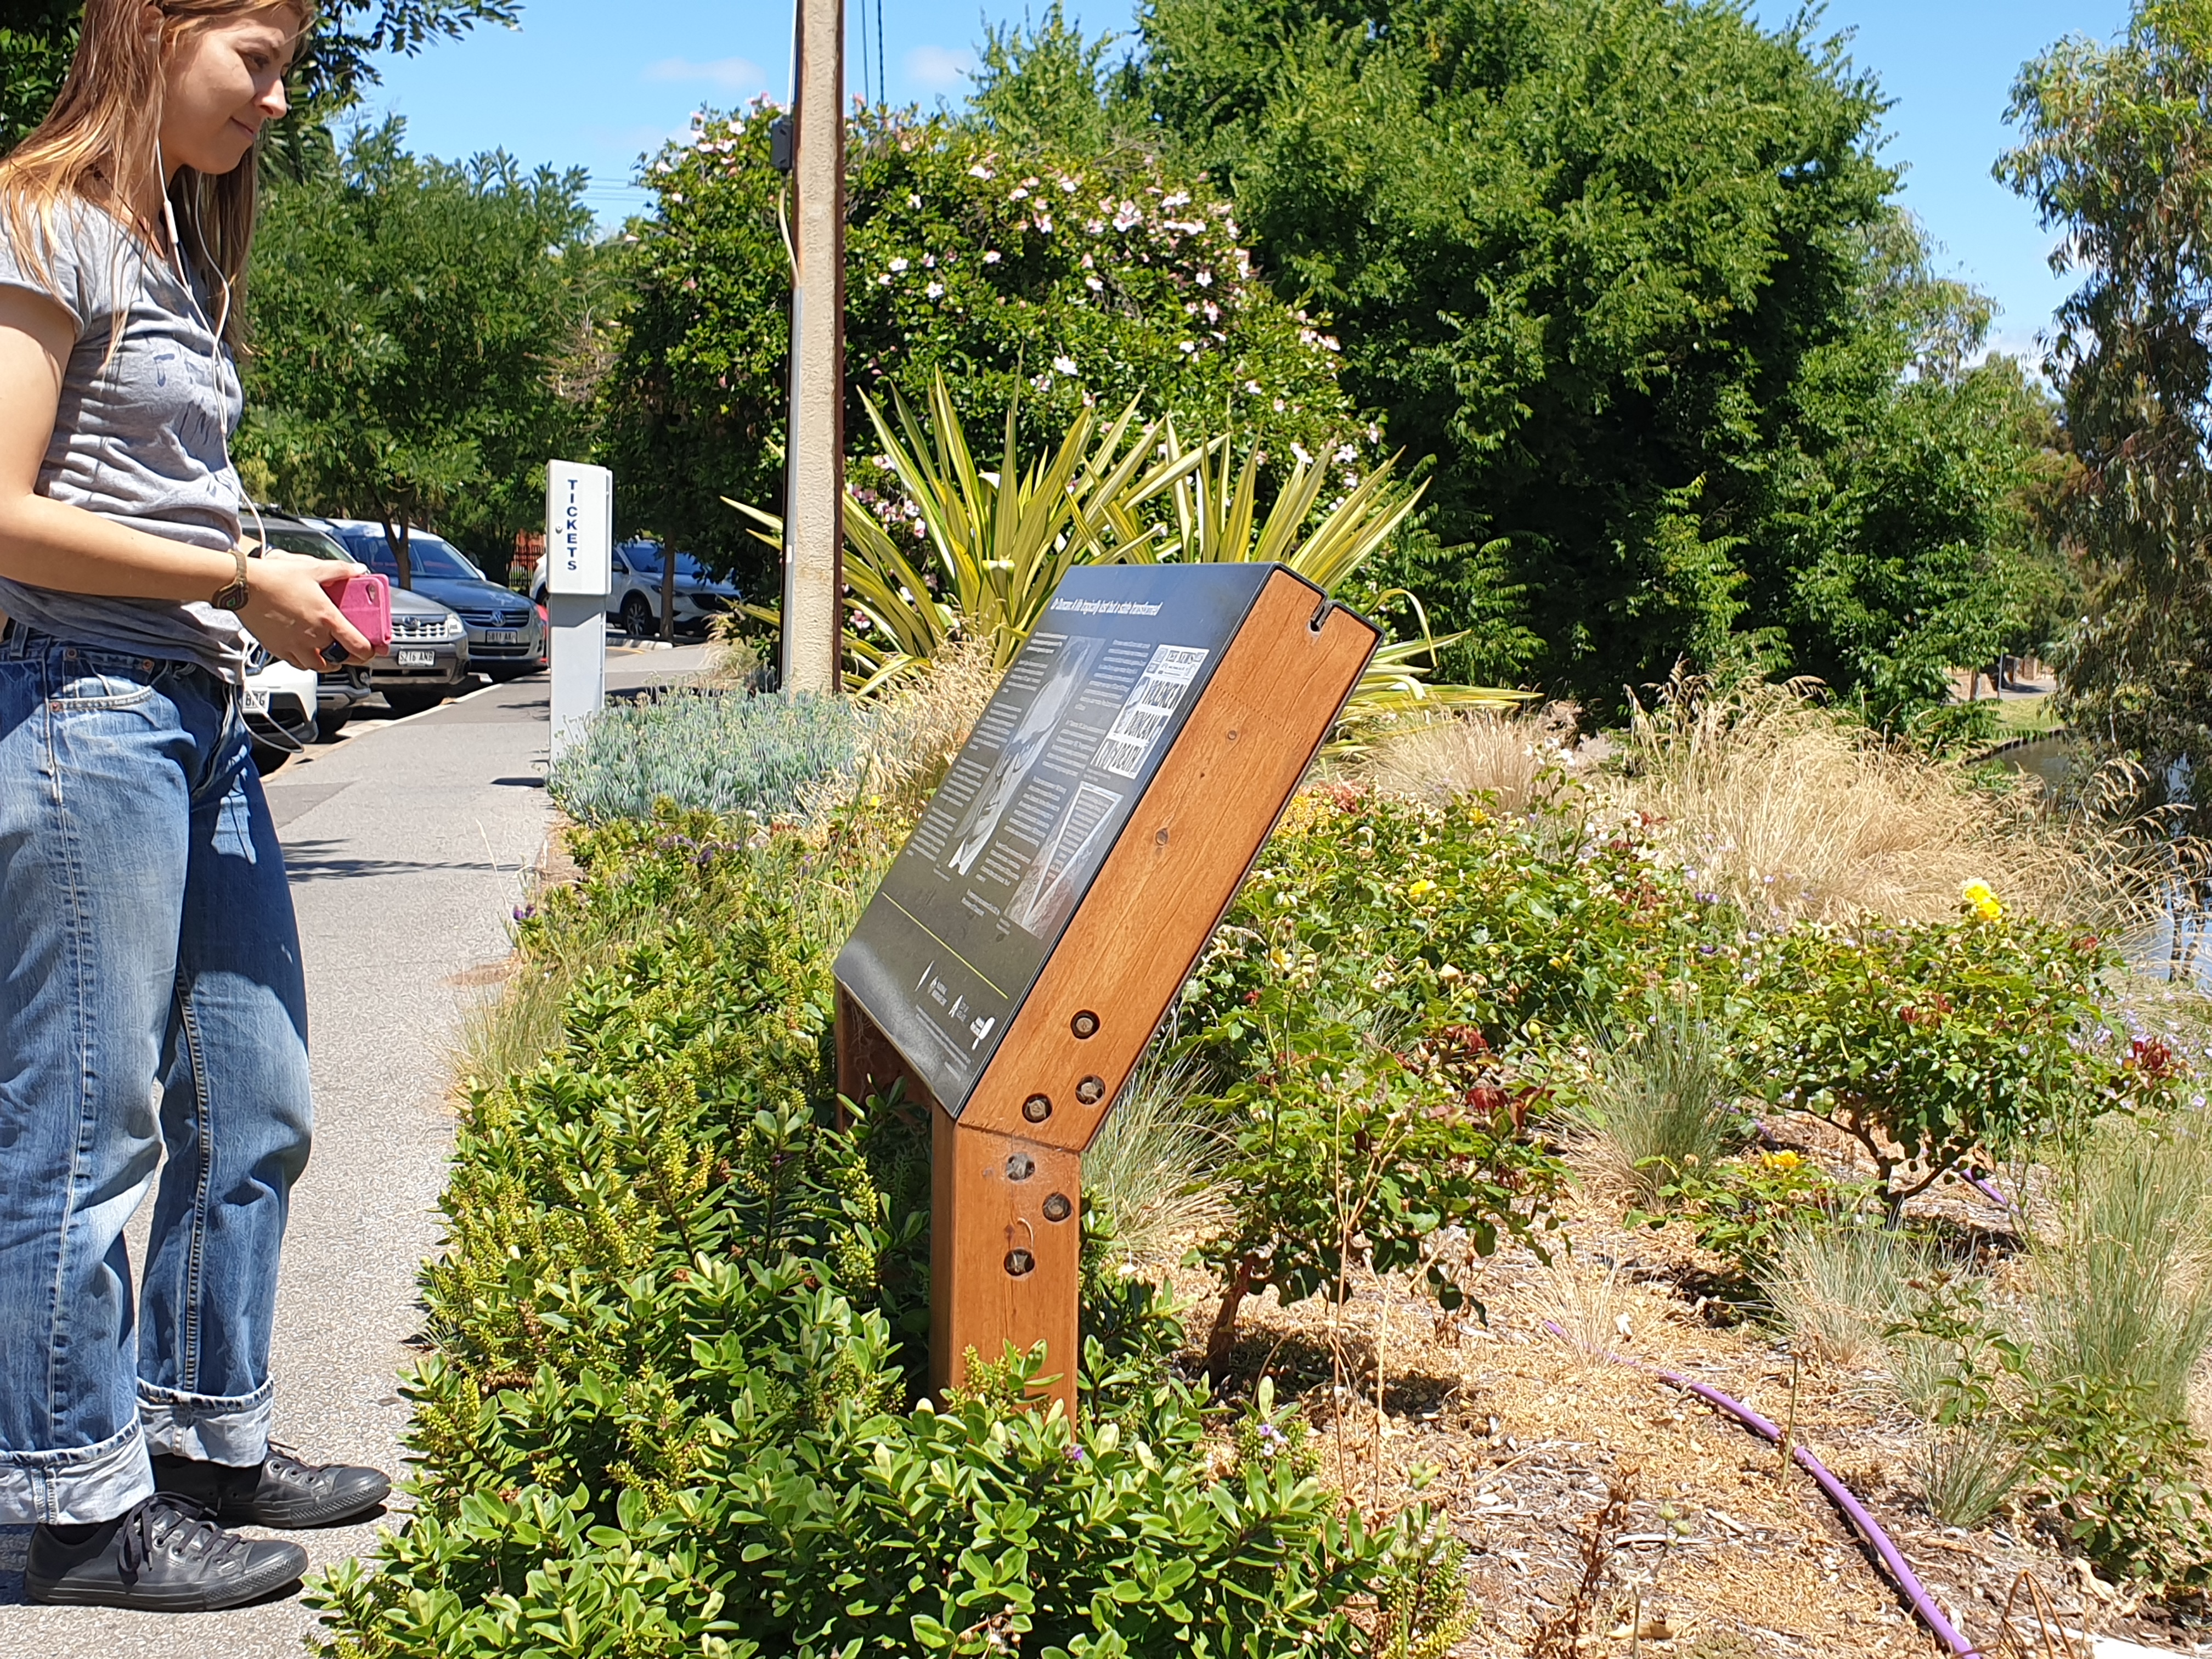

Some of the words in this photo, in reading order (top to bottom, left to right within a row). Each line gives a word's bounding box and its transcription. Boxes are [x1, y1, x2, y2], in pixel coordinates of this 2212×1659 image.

[567, 479, 578, 571] TICKETS
[1142, 679, 1180, 708] VIOLENCE
[1168, 684, 1187, 710] IN
[1124, 710, 1160, 740] DUNCAN
[1112, 742, 1142, 772] DEATH
